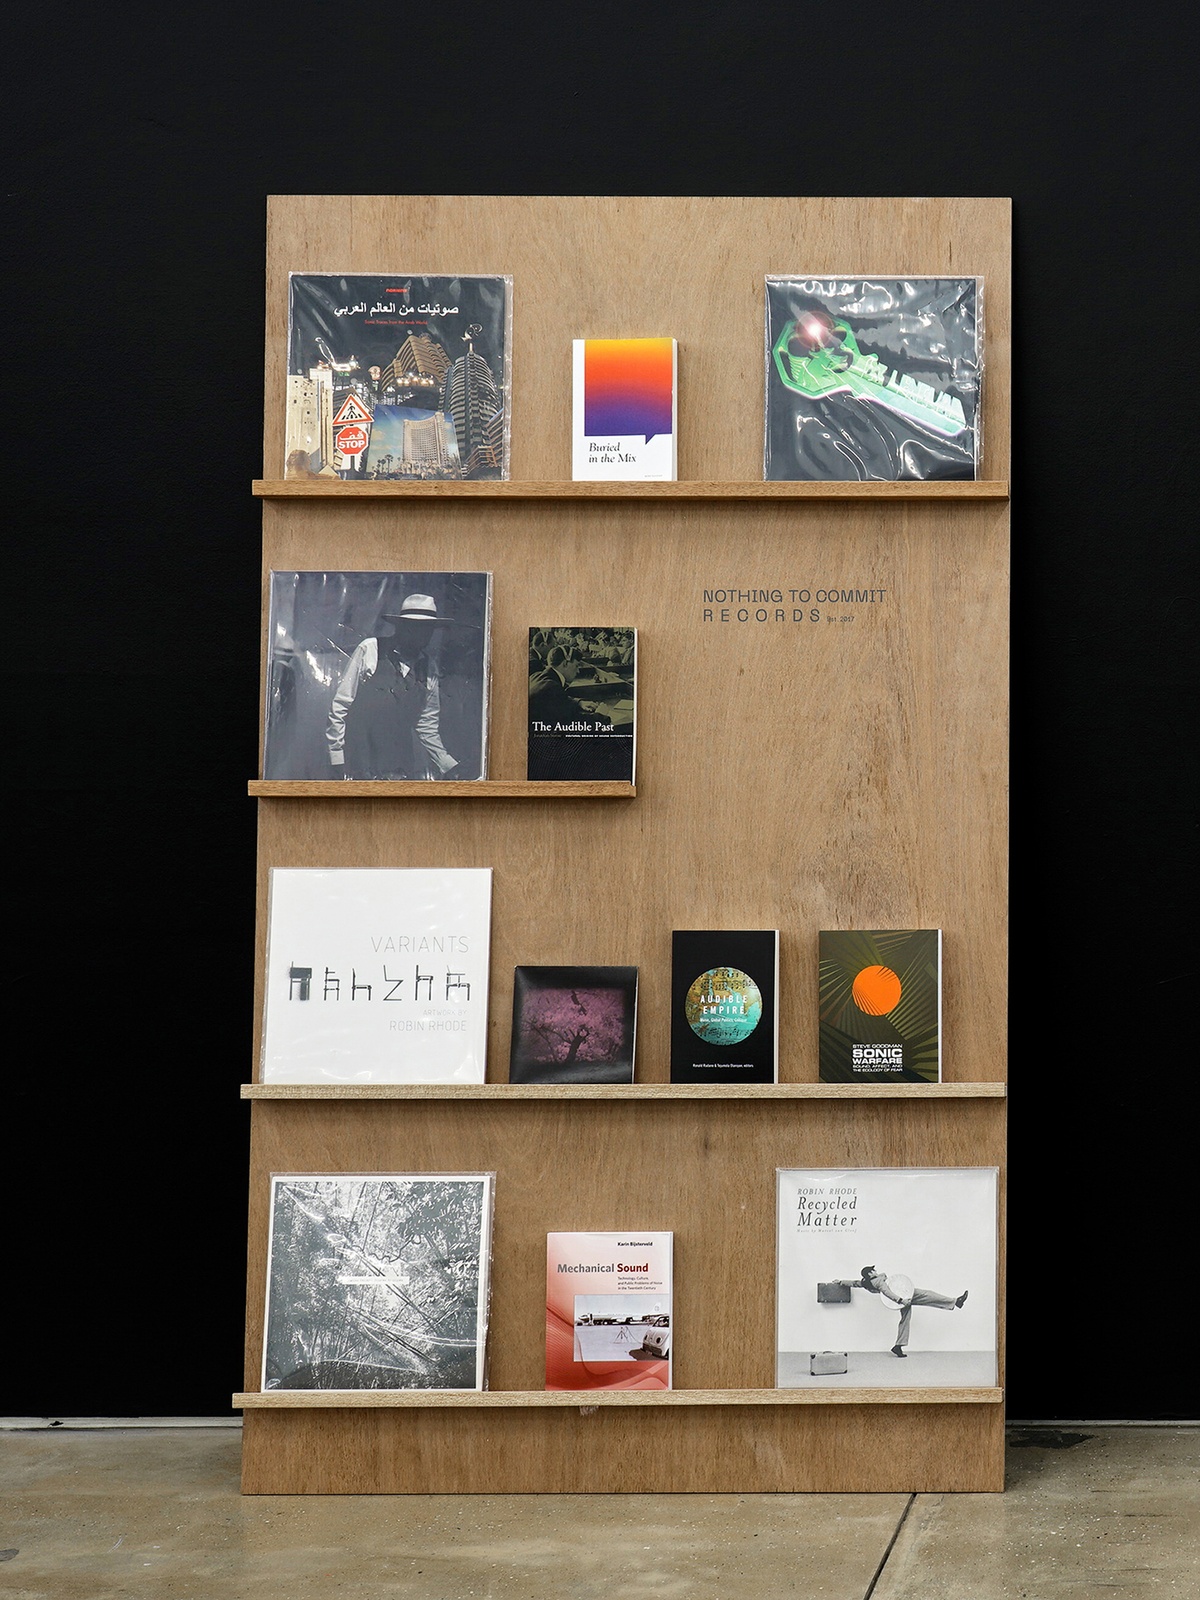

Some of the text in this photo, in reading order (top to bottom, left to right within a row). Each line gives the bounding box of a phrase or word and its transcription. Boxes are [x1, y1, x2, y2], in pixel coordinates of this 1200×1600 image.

[334, 301, 459, 317] صوتيات من العالم العربي
[339, 440, 365, 448] STOP
[589, 442, 620, 452] Buried
[588, 453, 637, 463] in the Mix
[703, 589, 887, 603] NOTHING TO COMMIT
[703, 609, 820, 622] RECORDS
[532, 721, 614, 732] The Audible Past
[371, 936, 469, 953] VARIANTS
[700, 995, 748, 1003] AUDIBLE
[703, 1006, 745, 1014] EMPIRE
[389, 1020, 467, 1031] ROBIN RHODE
[852, 1049, 903, 1057] SONIC
[797, 1196, 857, 1215] Recycled
[797, 1211, 857, 1226] Matter
[557, 1262, 649, 1273] Mechanical Sound
